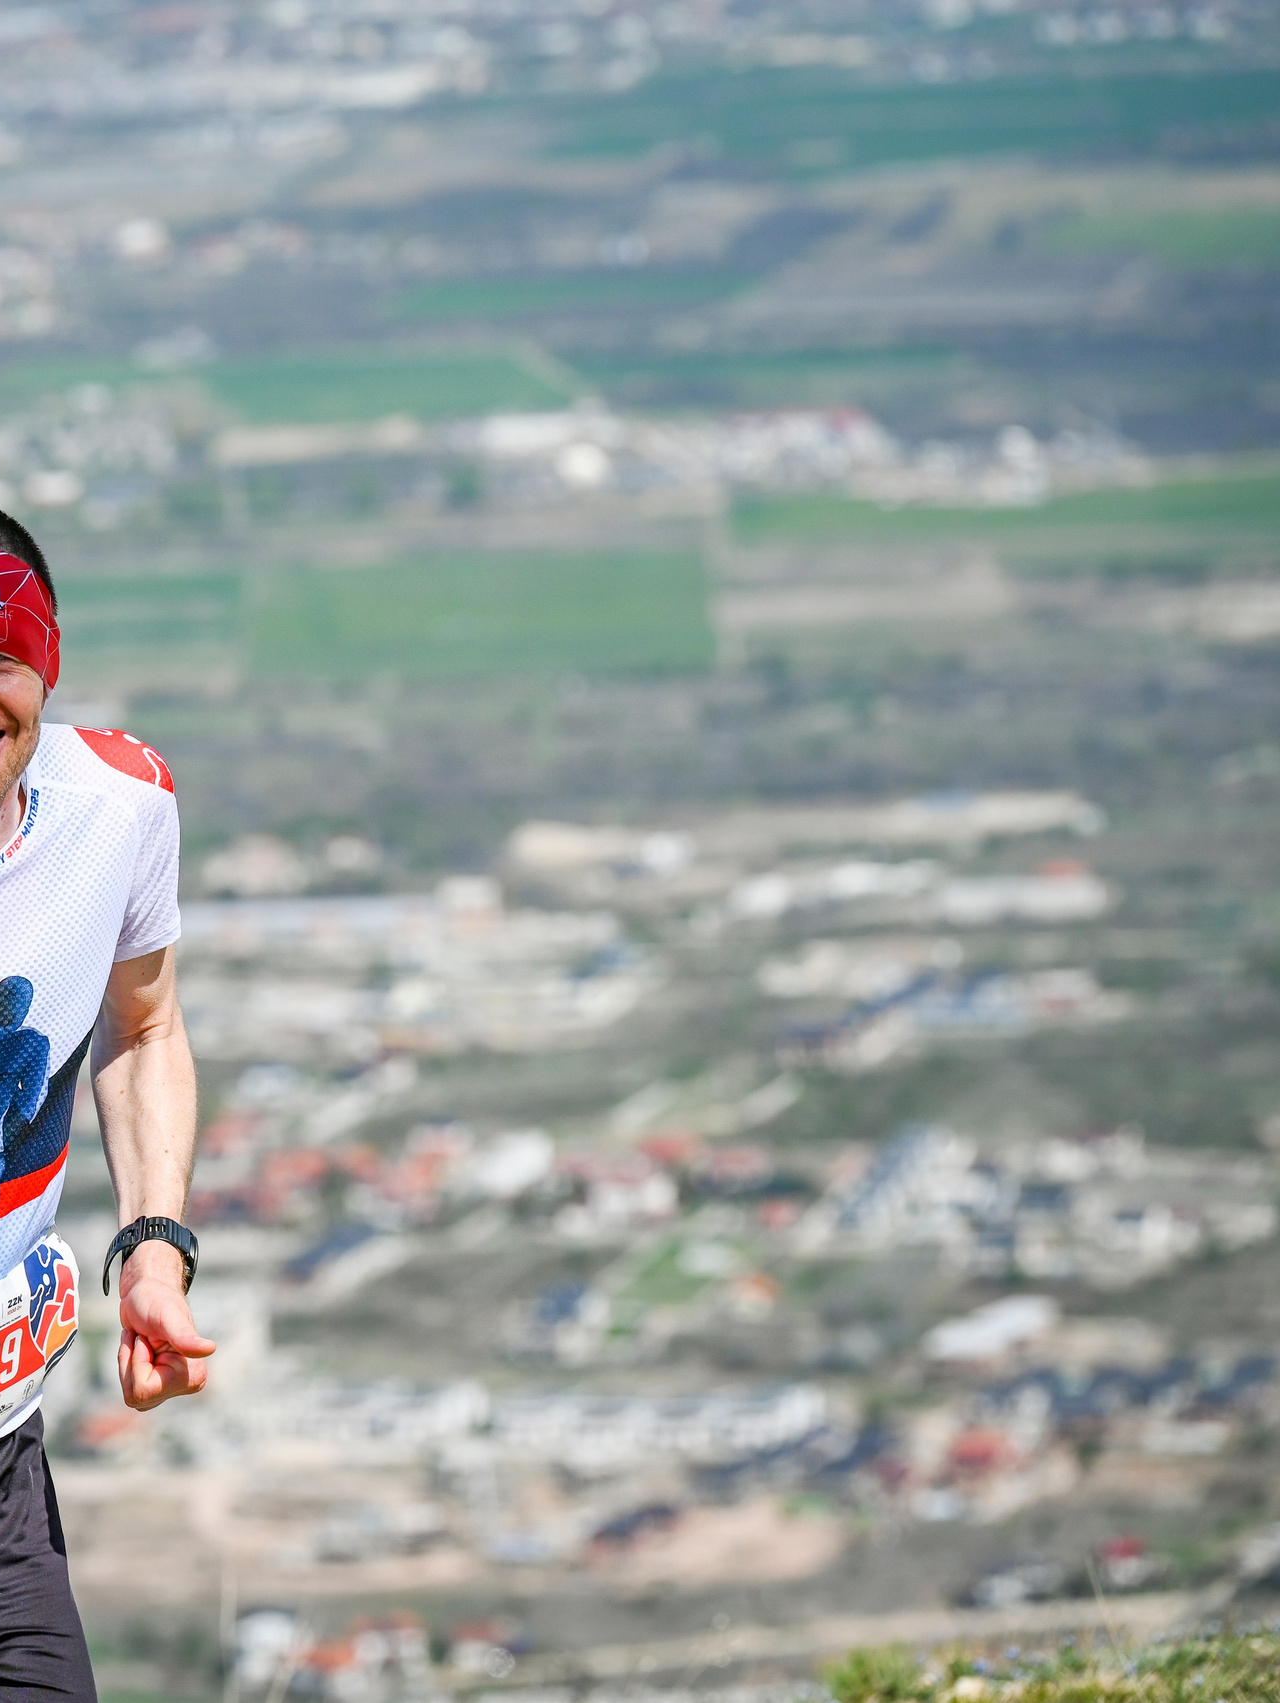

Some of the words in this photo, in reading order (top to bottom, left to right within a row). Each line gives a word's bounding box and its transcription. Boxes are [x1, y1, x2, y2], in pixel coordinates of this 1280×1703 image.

[5, 834, 23, 859] STEP
[21, 787, 40, 839] MATTERS
[7, 1294, 23, 1309] 22K
